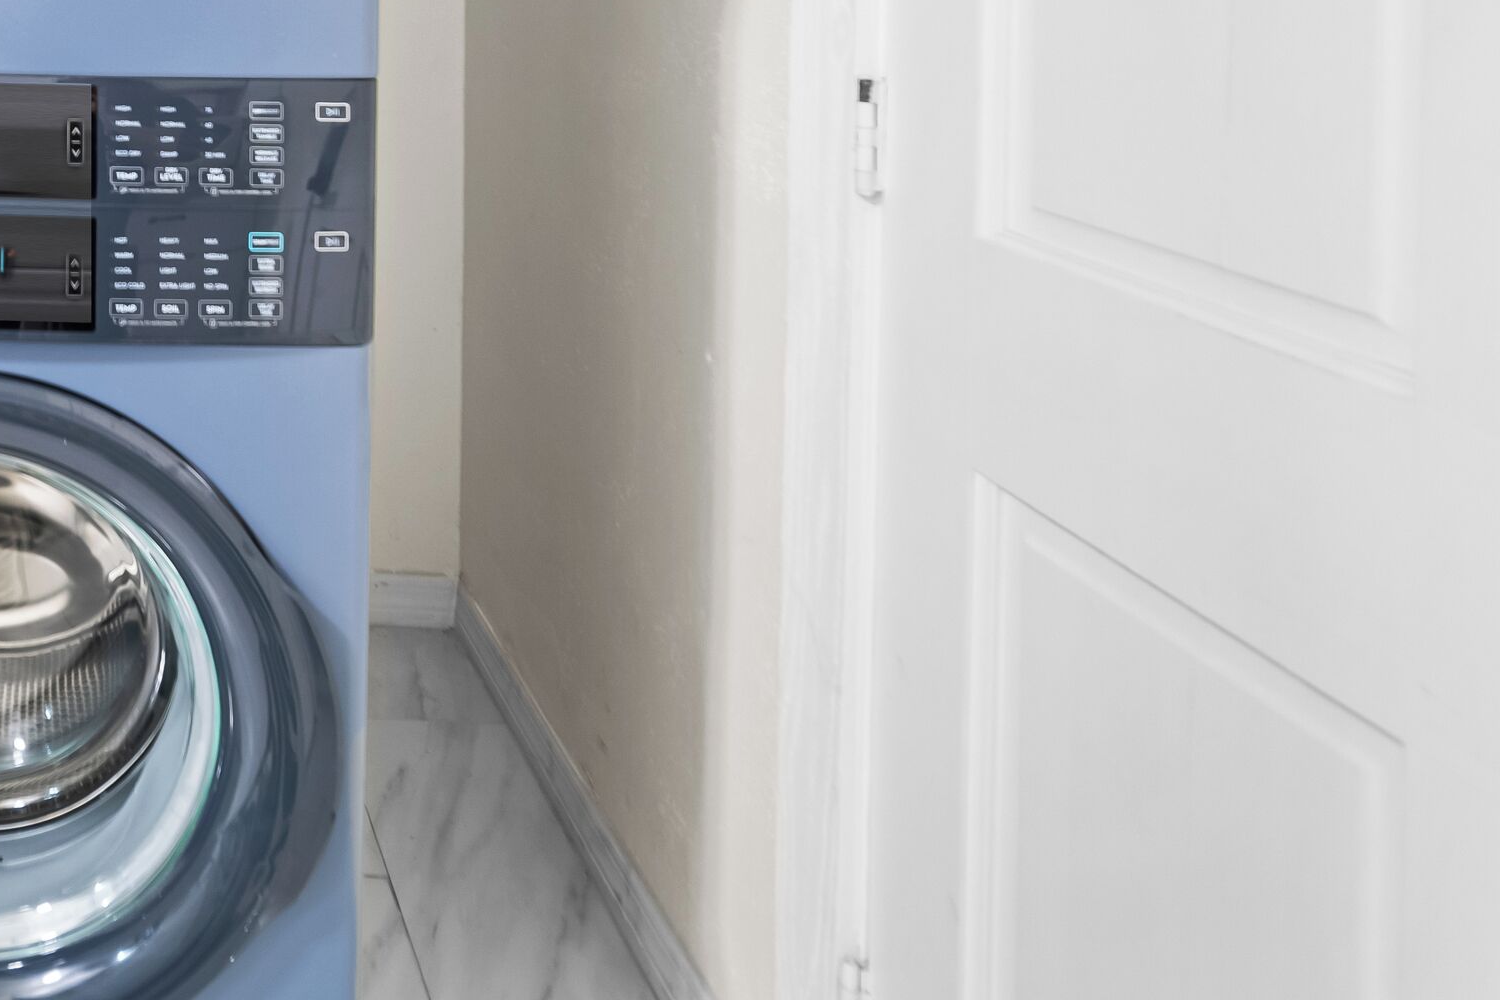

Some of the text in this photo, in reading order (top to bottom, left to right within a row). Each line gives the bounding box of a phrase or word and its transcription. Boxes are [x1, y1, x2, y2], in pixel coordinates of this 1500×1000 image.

[116, 172, 139, 181] TEMP
[207, 173, 227, 183] TIME
[115, 304, 138, 314] TEMP
